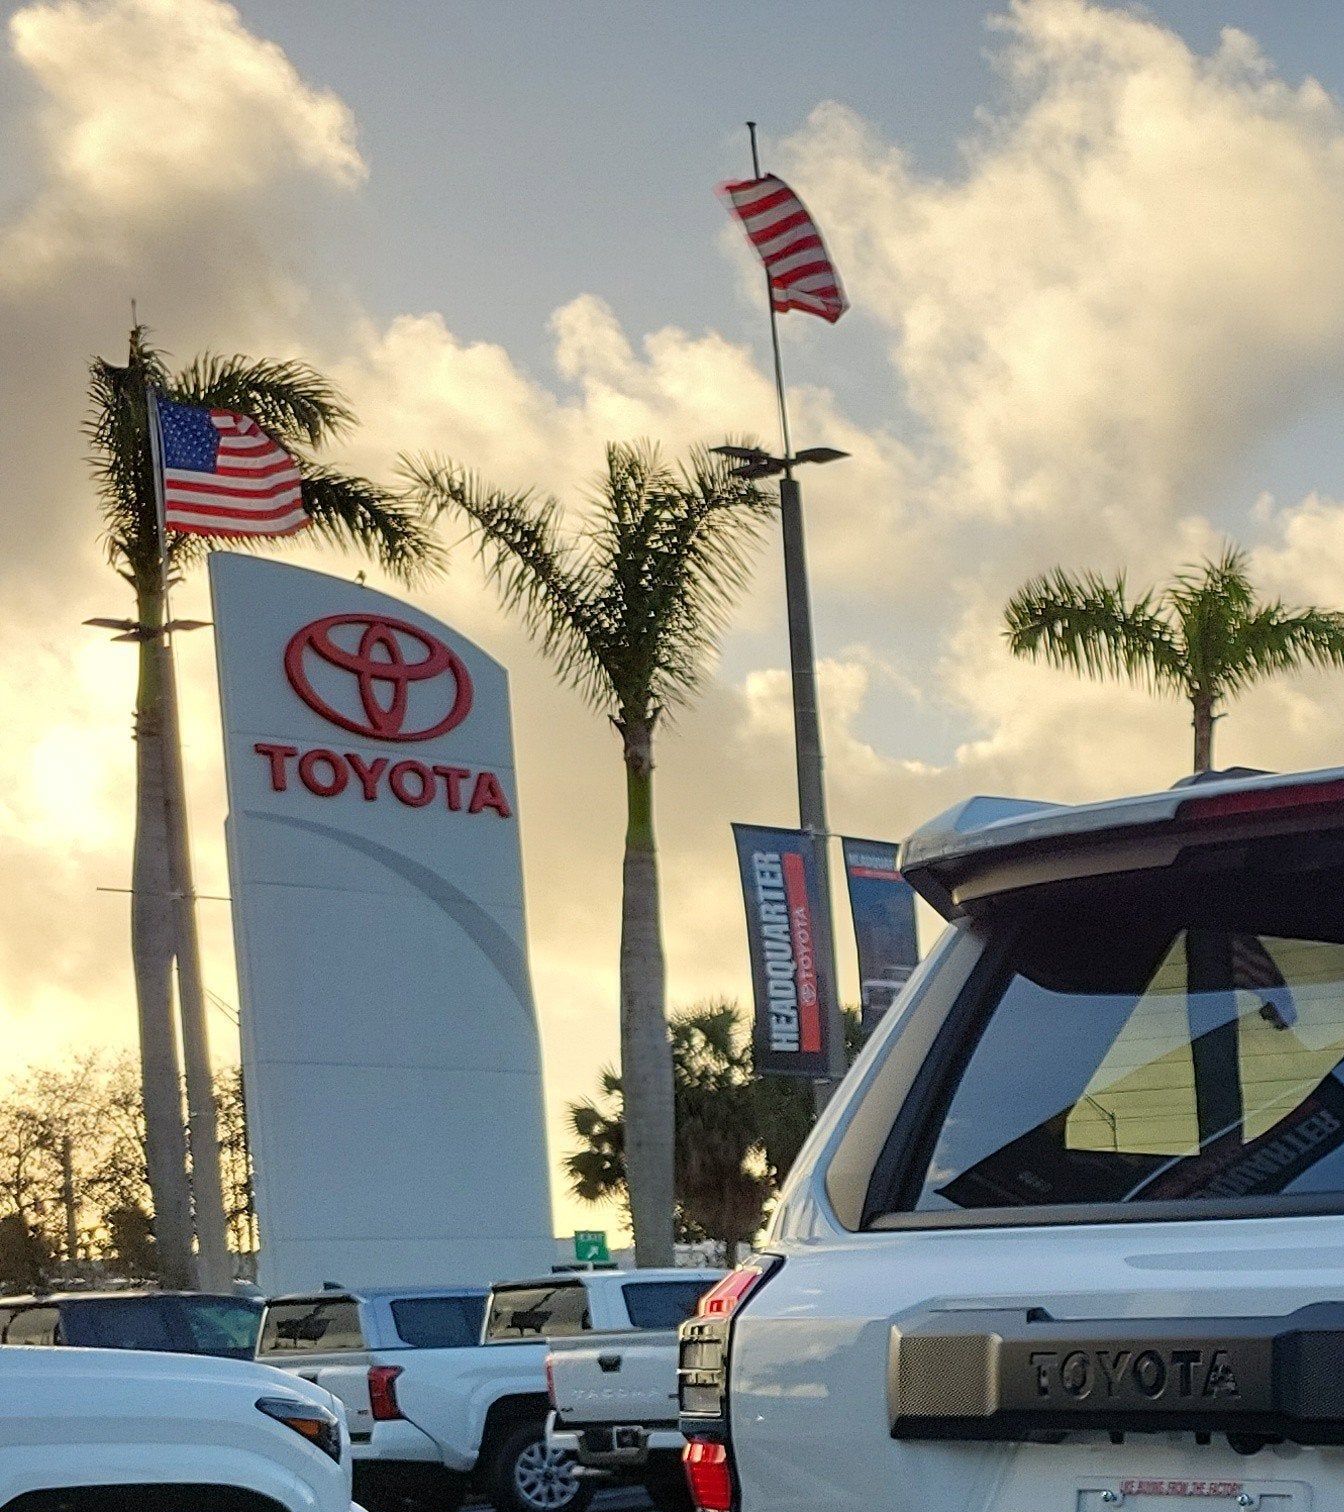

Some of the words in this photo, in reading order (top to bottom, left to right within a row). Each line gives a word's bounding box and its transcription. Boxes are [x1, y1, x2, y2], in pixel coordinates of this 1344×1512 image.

[254, 743, 512, 818] TOYOTA
[753, 851, 800, 1052] HEADQUARTER
[795, 906, 814, 980] TOYOTA
[1030, 1350, 1241, 1400] TOYOTA
